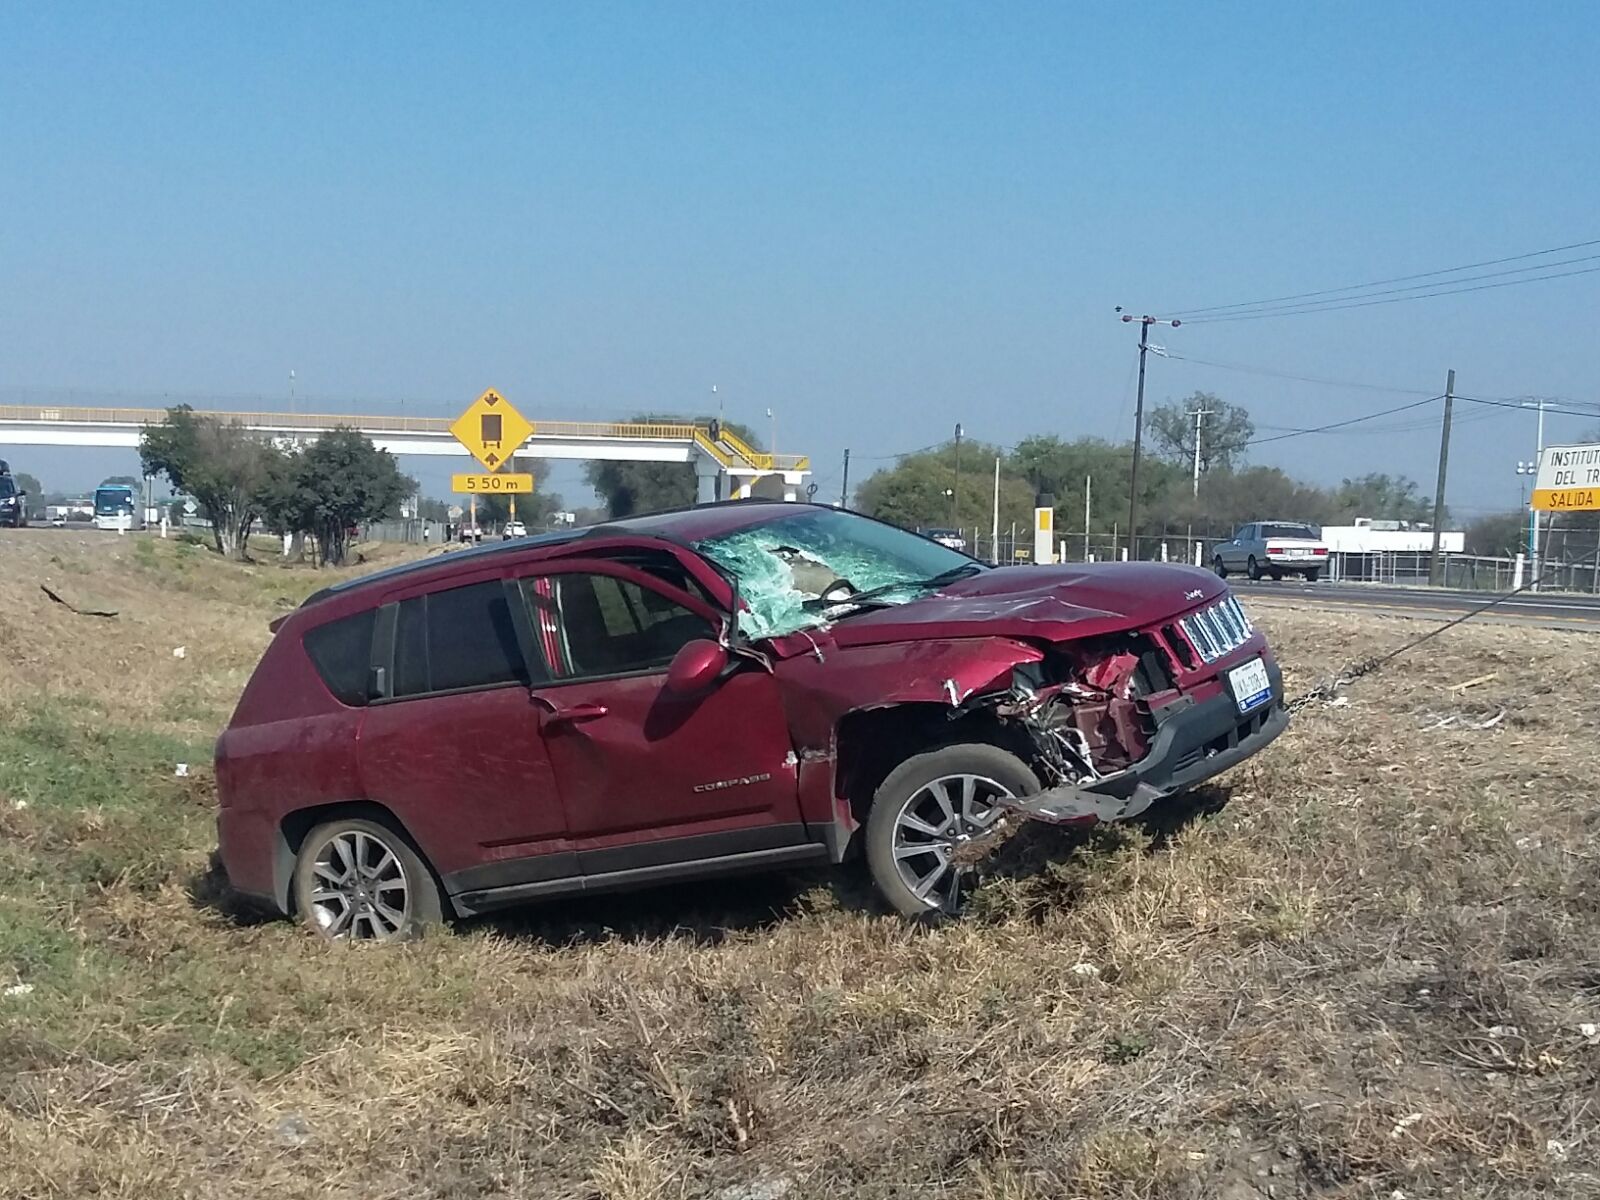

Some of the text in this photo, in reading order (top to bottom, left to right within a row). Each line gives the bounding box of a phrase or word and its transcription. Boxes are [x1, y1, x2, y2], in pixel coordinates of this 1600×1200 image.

[1551, 450, 1600, 466] INSTITUT
[506, 481, 518, 489] m
[1555, 470, 1576, 485] DEL
[1549, 491, 1593, 507] SALIDA
[693, 773, 771, 792] COMPASS
